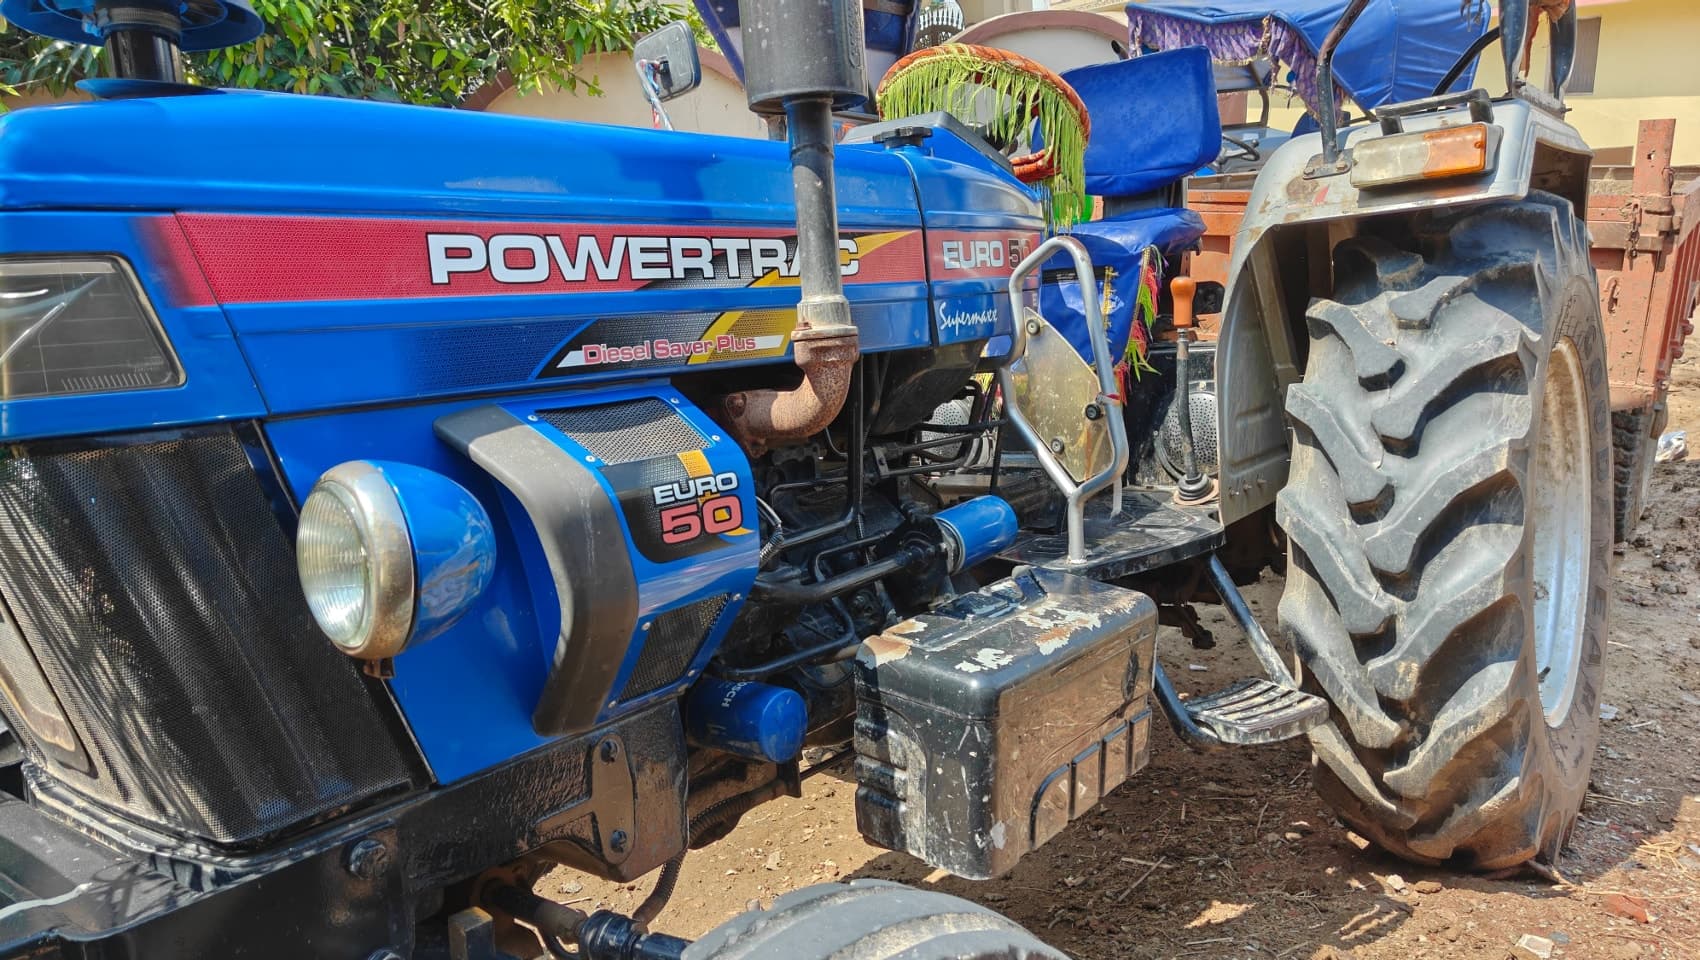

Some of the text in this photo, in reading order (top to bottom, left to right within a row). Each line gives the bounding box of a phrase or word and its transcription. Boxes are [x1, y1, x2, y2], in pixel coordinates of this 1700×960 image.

[942, 240, 1005, 270] EURO
[583, 333, 757, 365] Diesel Saver Plus
[653, 471, 739, 505] EURO
[661, 495, 743, 544] 50
